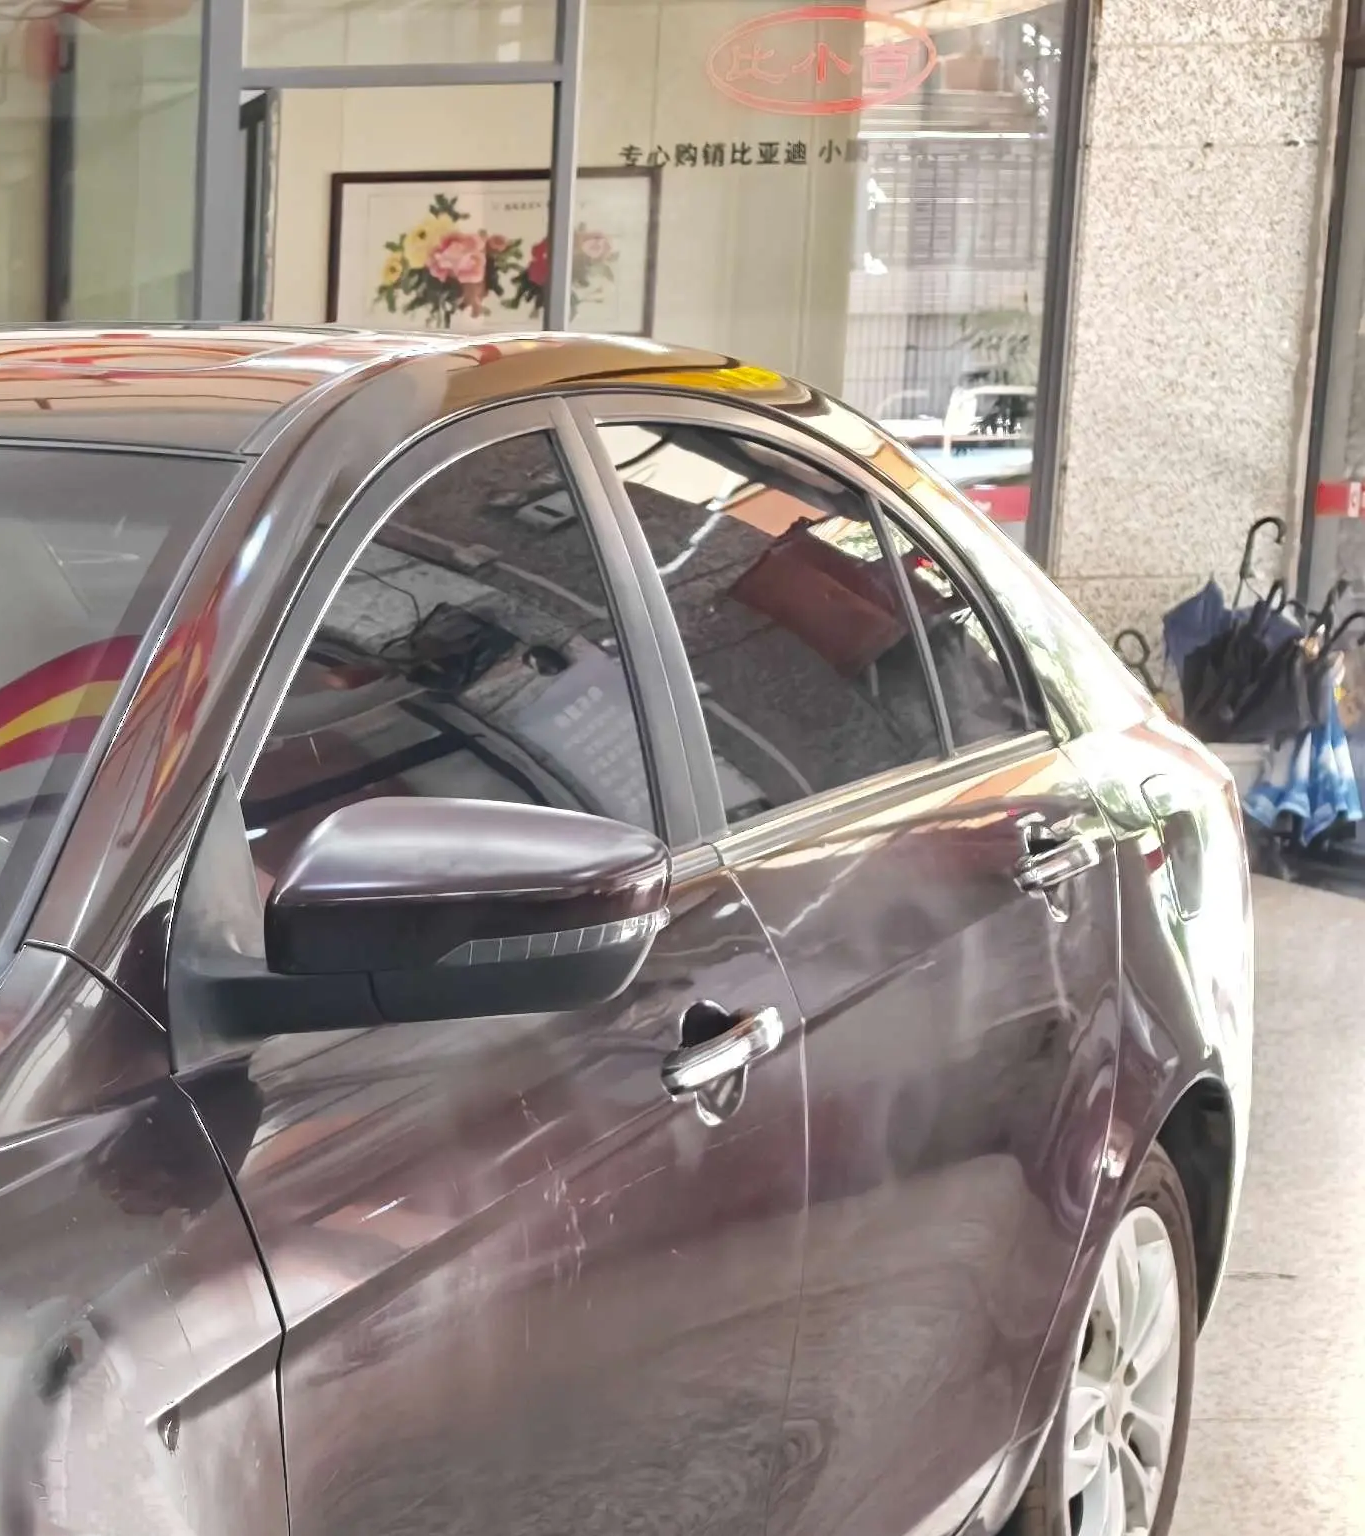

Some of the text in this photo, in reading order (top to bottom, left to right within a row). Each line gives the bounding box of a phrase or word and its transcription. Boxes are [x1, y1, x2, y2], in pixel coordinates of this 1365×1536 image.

[618, 139, 808, 168] 专心购销比亚迪
